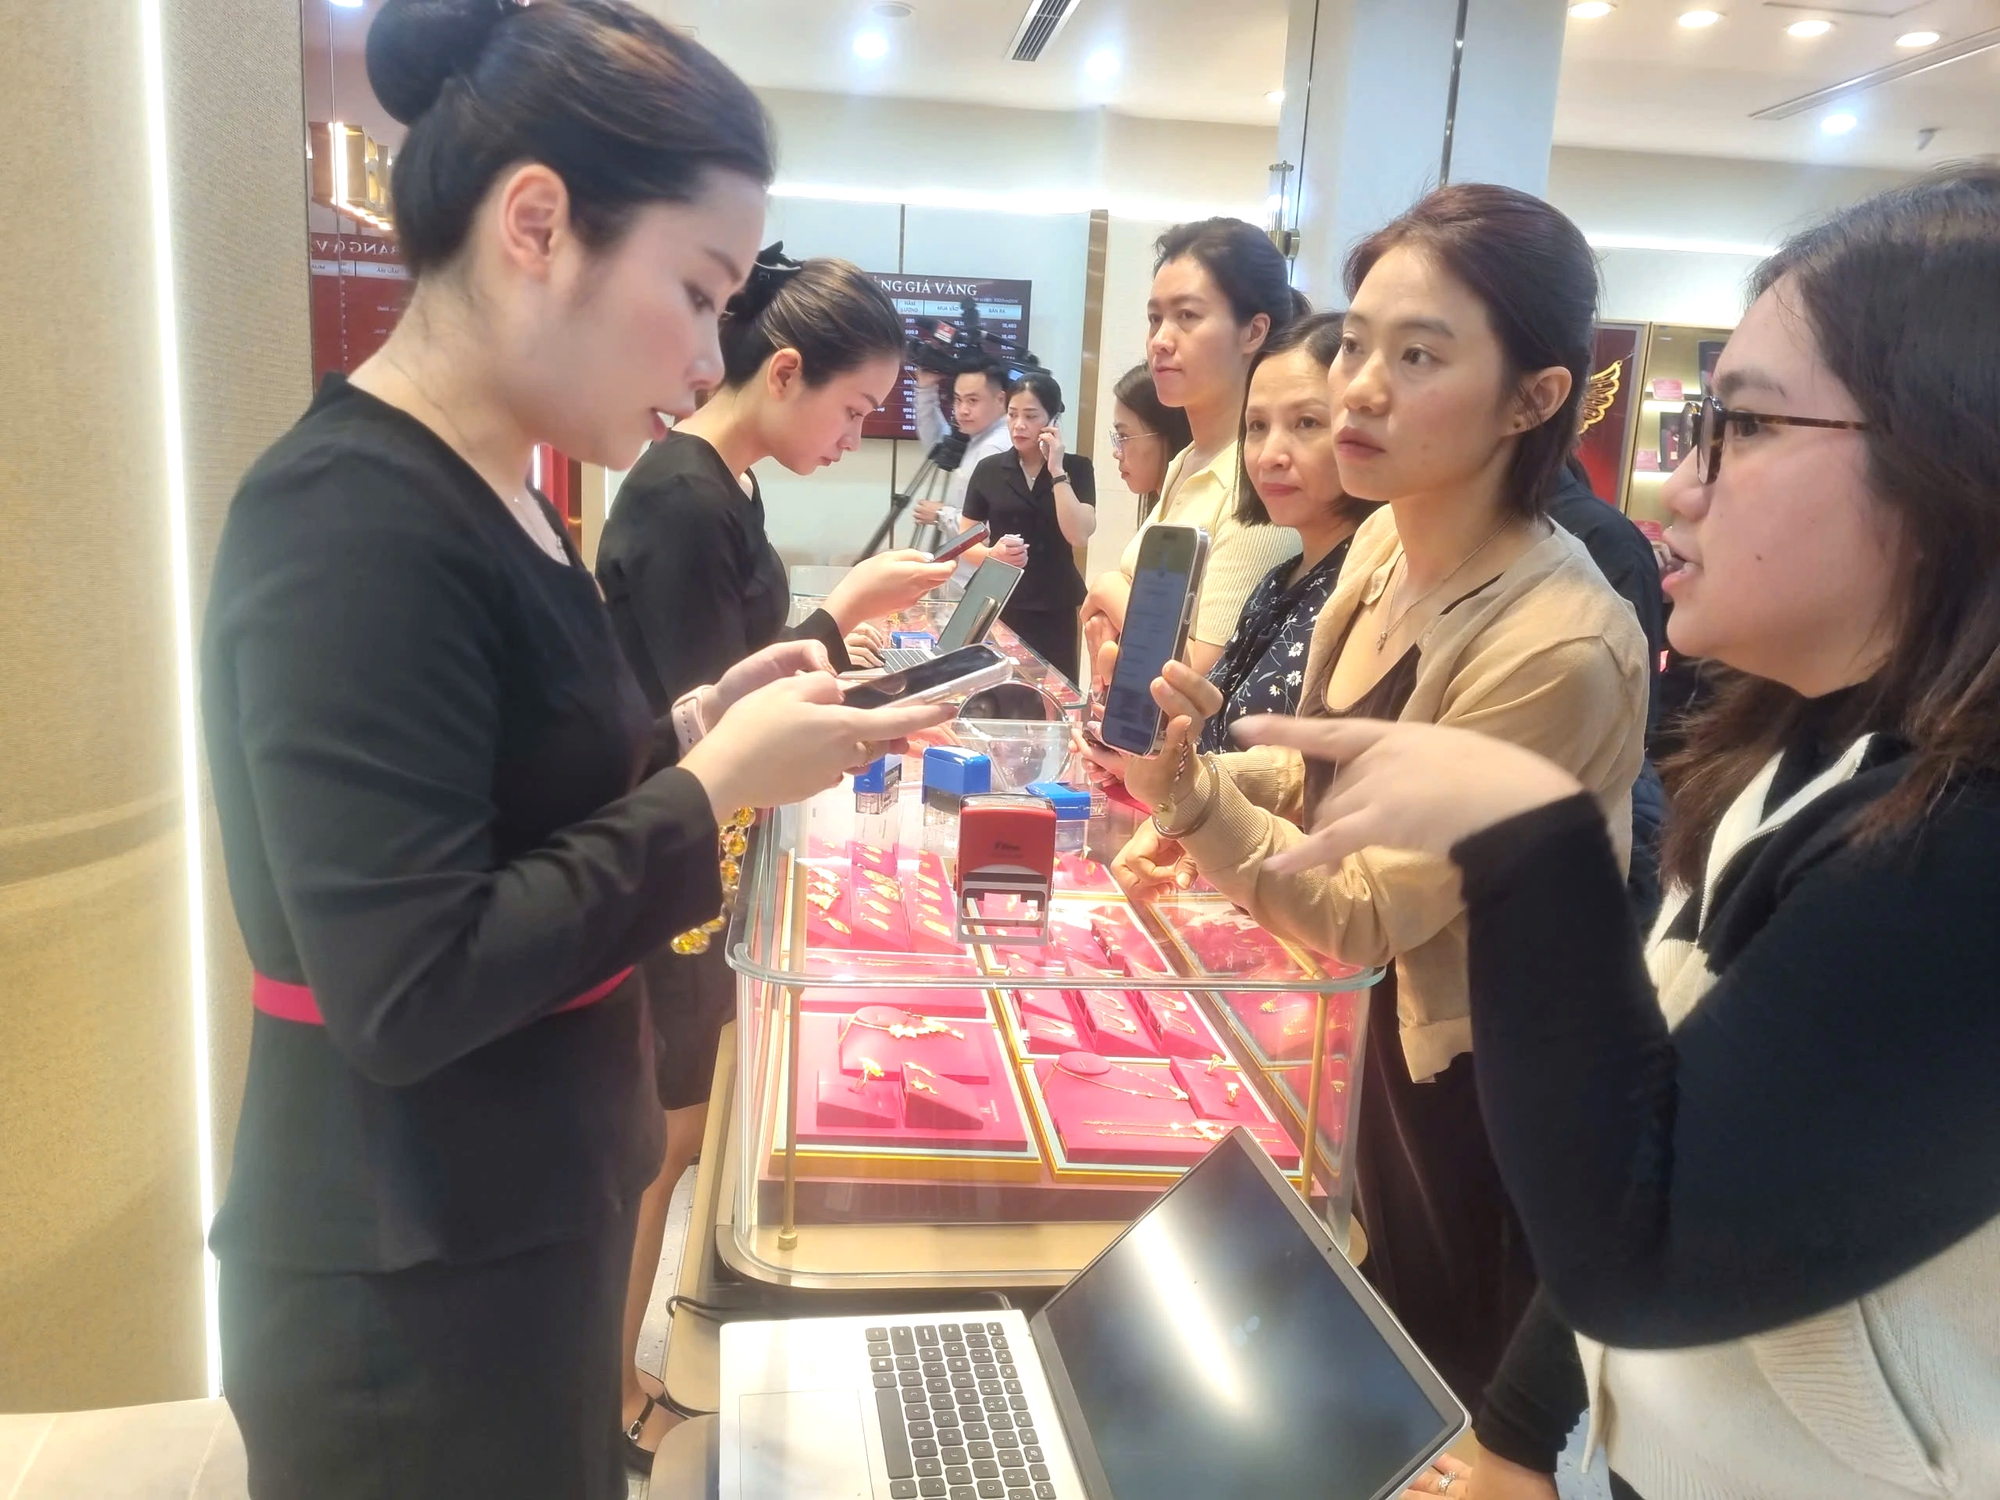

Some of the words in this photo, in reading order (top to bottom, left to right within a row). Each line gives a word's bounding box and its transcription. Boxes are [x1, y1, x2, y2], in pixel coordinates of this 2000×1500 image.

[878, 278, 903, 293] NG
[905, 279, 932, 294] GIÁ
[934, 280, 978, 296] VÀNG
